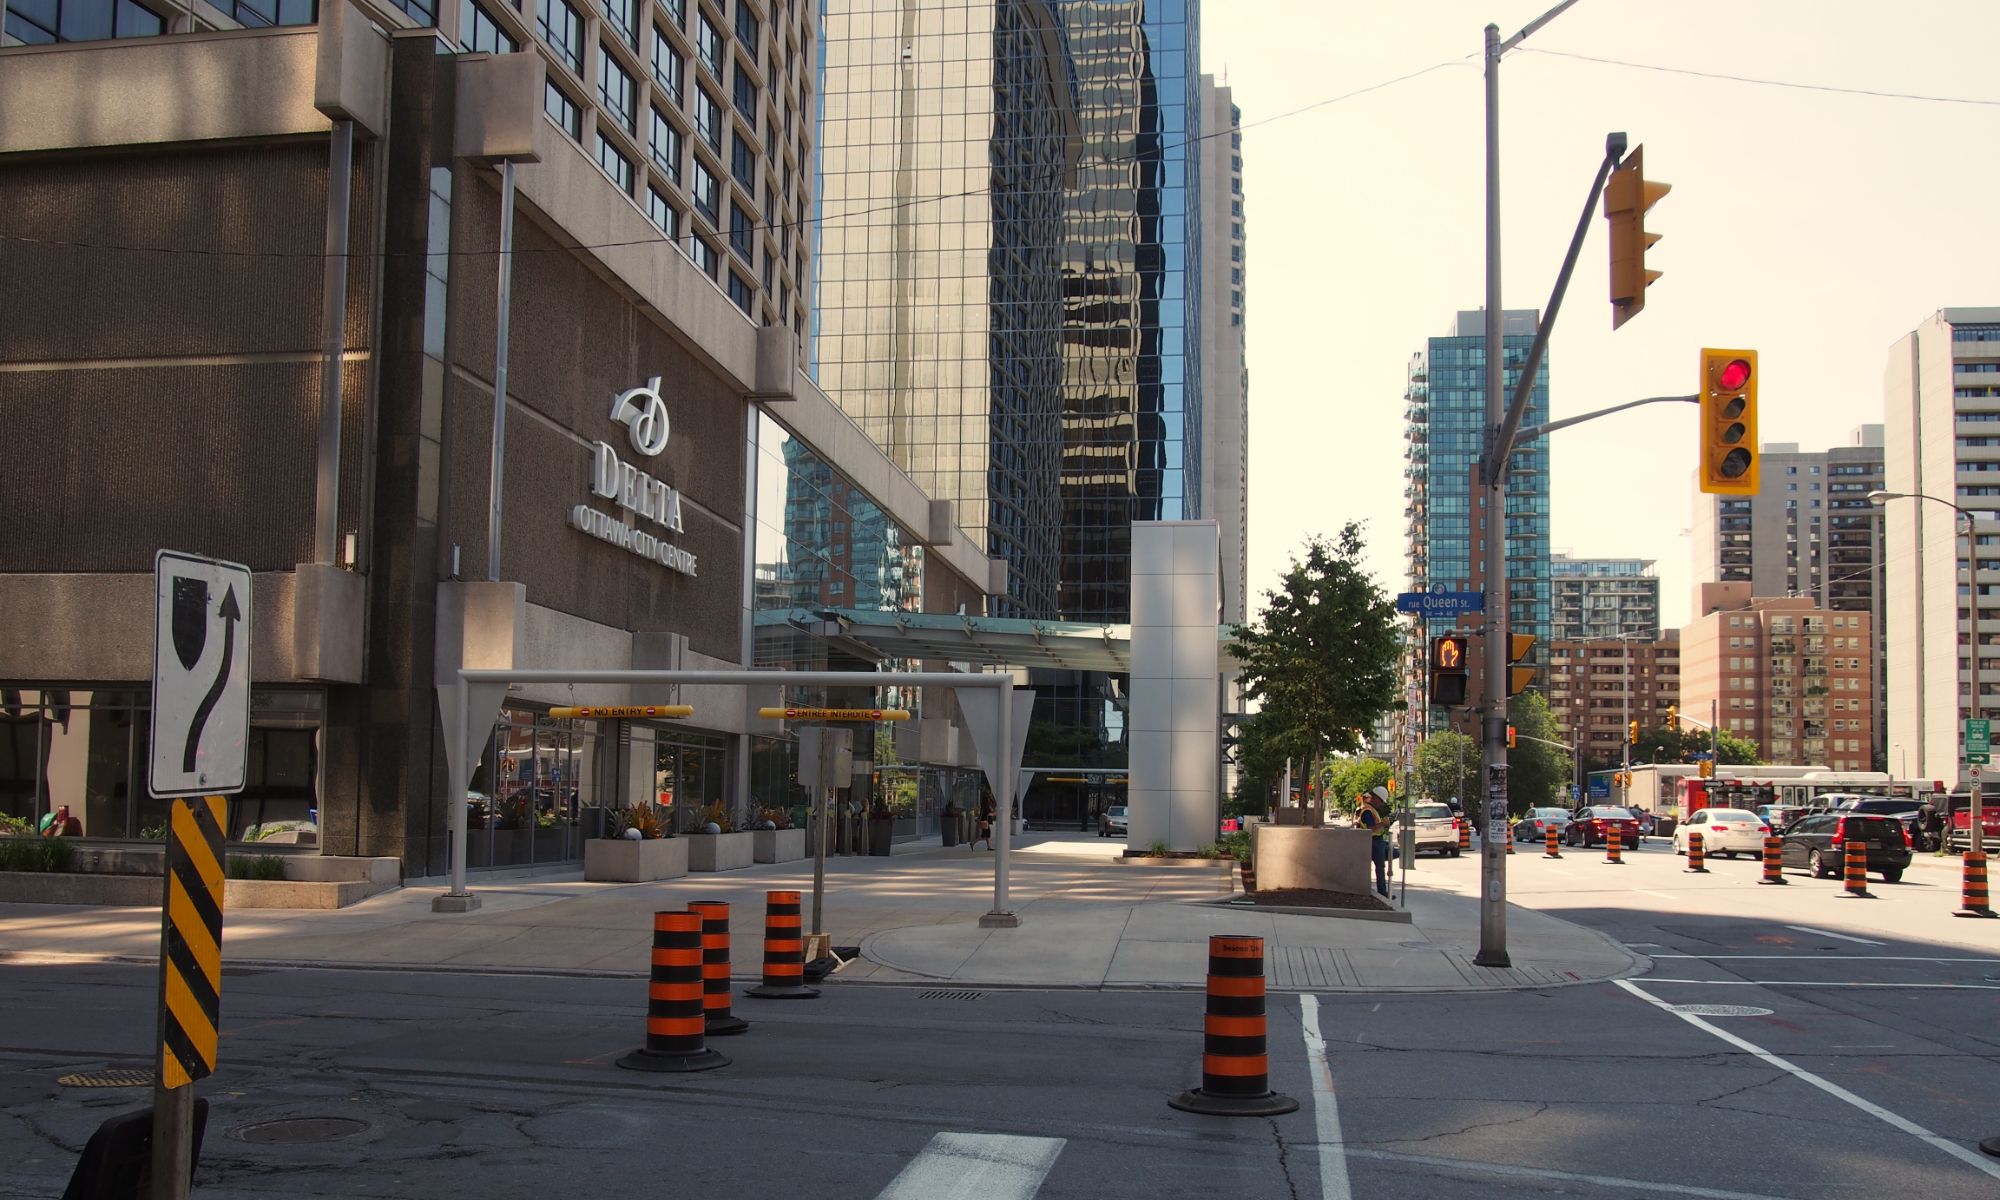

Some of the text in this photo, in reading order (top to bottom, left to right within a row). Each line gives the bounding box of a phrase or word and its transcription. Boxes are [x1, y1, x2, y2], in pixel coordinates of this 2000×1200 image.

[591, 440, 685, 535] DELTA
[573, 504, 698, 578] OTTAWA CITY CENTRE
[1423, 595, 1458, 610] Queen
[1460, 599, 1470, 608] St.
[594, 707, 642, 716] NO ENTRY
[830, 710, 870, 718] INTERDITE
[1223, 944, 1249, 952] Beacon
